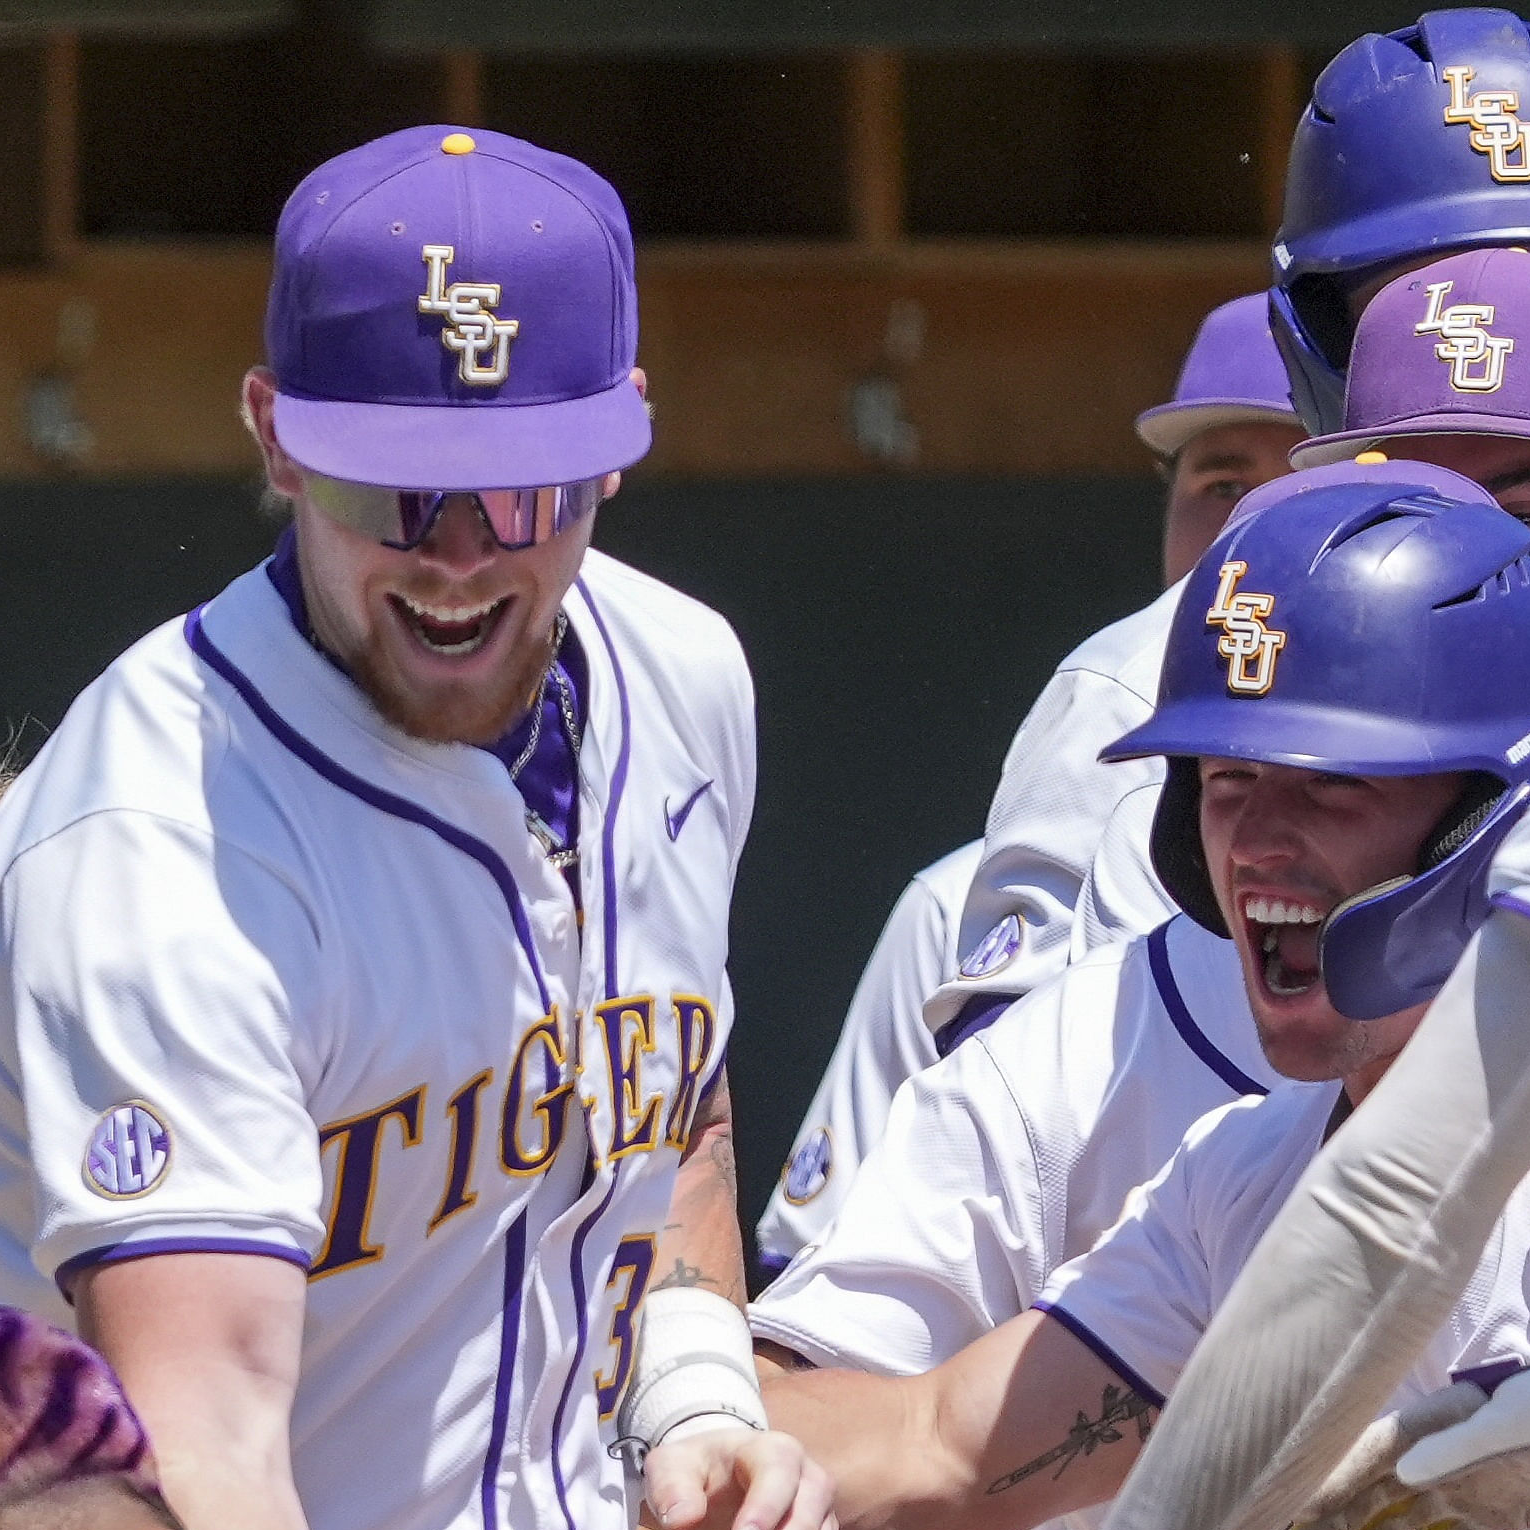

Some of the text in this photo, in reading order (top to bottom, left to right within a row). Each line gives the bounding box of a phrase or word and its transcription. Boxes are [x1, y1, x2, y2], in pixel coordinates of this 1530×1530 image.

[417, 244, 520, 386] LSU
[1414, 280, 1514, 394] LSU
[1205, 560, 1286, 695] LSU
[87, 1105, 168, 1194] SEC
